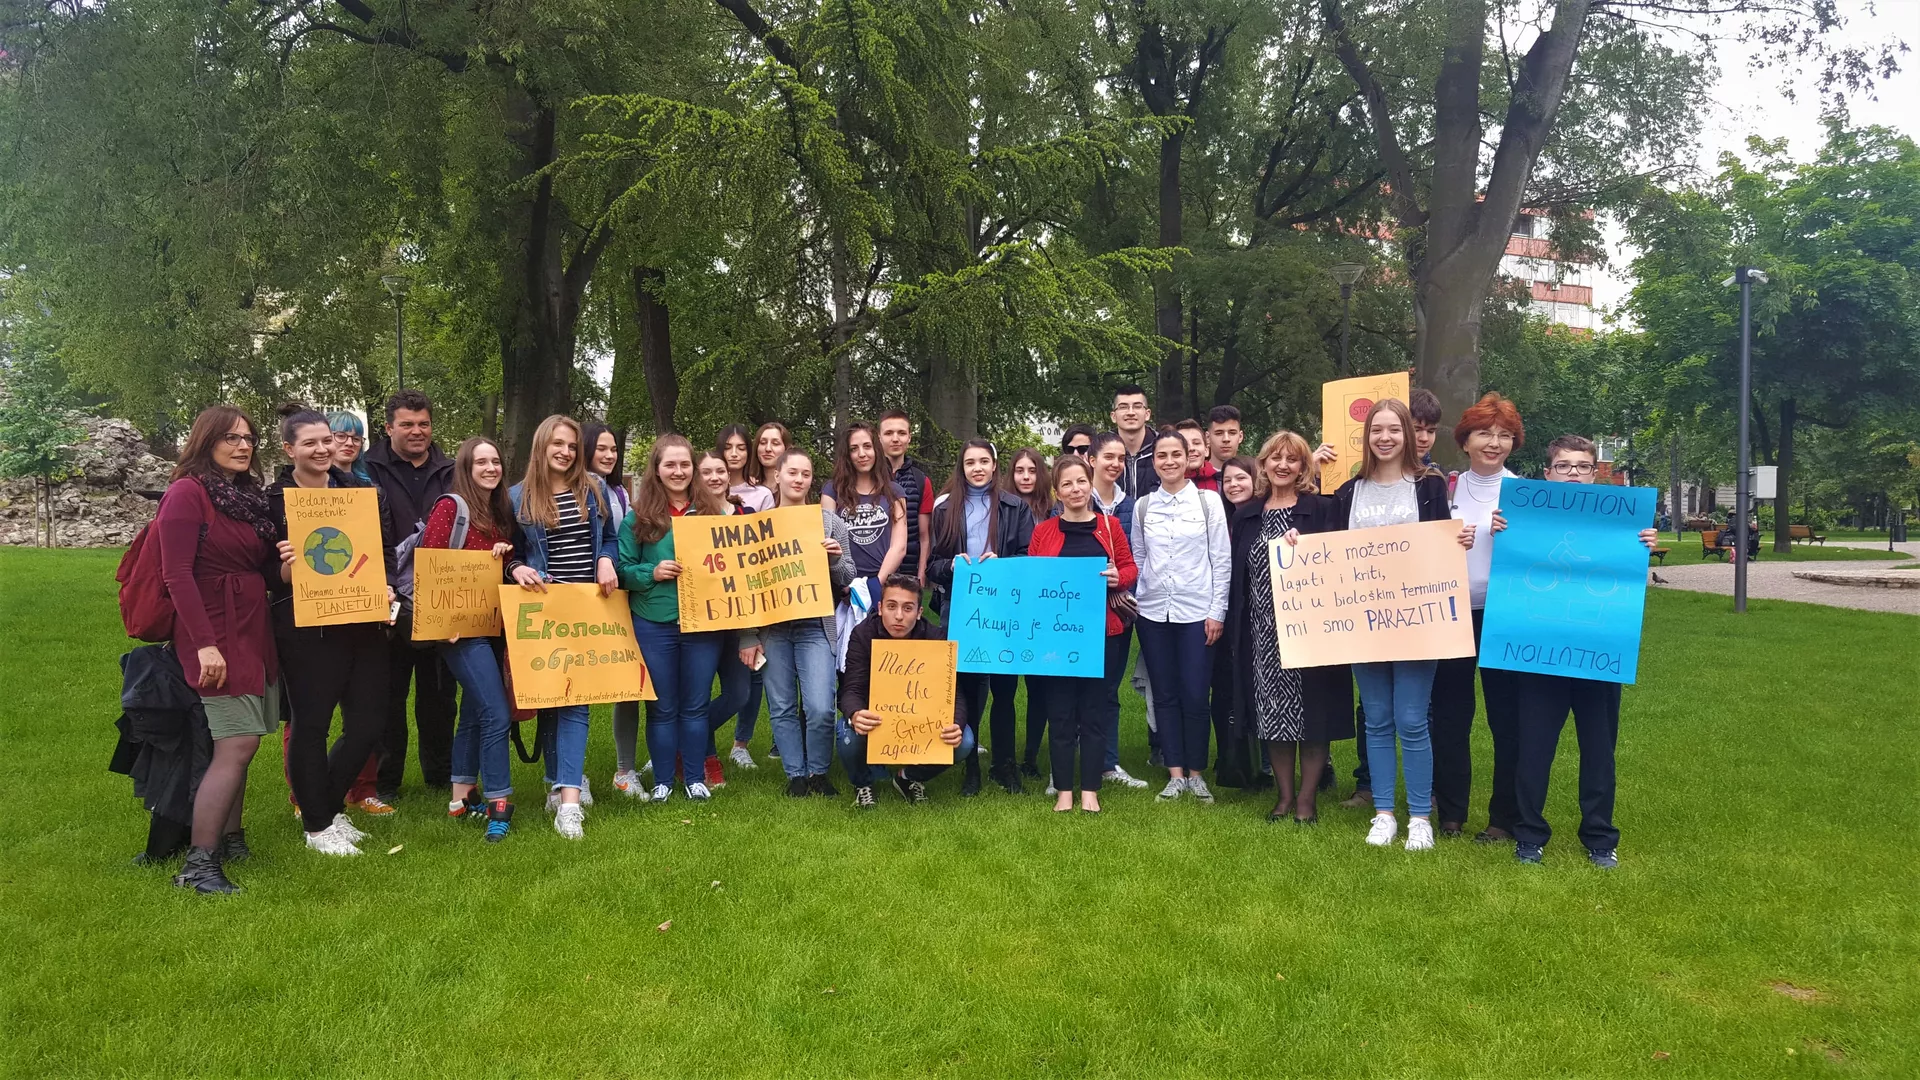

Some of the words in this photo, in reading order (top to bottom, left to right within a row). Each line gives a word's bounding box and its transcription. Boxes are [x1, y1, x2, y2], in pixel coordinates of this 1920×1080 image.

[290, 491, 328, 508] Jedan
[1511, 486, 1636, 516] SOLUTION
[296, 507, 347, 521] podsetnik:
[1355, 504, 1386, 523] JOIN
[711, 518, 775, 549] ИМАМ
[429, 556, 456, 575] Nijedna
[703, 553, 726, 574] 16
[737, 539, 803, 568] ГОДИНА
[1276, 542, 1334, 569] Uvek
[1345, 540, 1410, 561] možemo
[436, 576, 454, 585] vrsta
[722, 575, 737, 593] И
[746, 560, 806, 590] ЖЕЛИМ
[1280, 572, 1324, 592] lagati
[1339, 573, 1344, 584] i
[1353, 565, 1386, 581] kriti,
[301, 583, 334, 599] Nemamo
[340, 583, 370, 597] drugu
[431, 586, 488, 610] UNIŠTILA
[706, 583, 820, 621] БУДУЋНОСТ
[968, 573, 998, 596] Речи
[1011, 587, 1021, 604] су
[1038, 580, 1081, 612] добре
[1282, 596, 1303, 611] ali
[1311, 599, 1324, 608] u
[1334, 588, 1396, 607] biološkim
[1401, 579, 1459, 599] terminima
[472, 607, 498, 628] DOM!
[517, 602, 627, 640] Еколошко
[966, 608, 1020, 638] Акција
[1027, 619, 1041, 640] је
[1053, 614, 1084, 633] боља
[1286, 620, 1308, 637] mi
[1324, 618, 1354, 633] smo
[1364, 596, 1458, 631] PARAZITI!
[879, 650, 925, 675] Make
[1503, 643, 1621, 675] POLLUTION
[905, 680, 932, 700] the
[875, 702, 917, 714] world
[895, 717, 943, 740] Greta
[880, 739, 932, 760] again!
